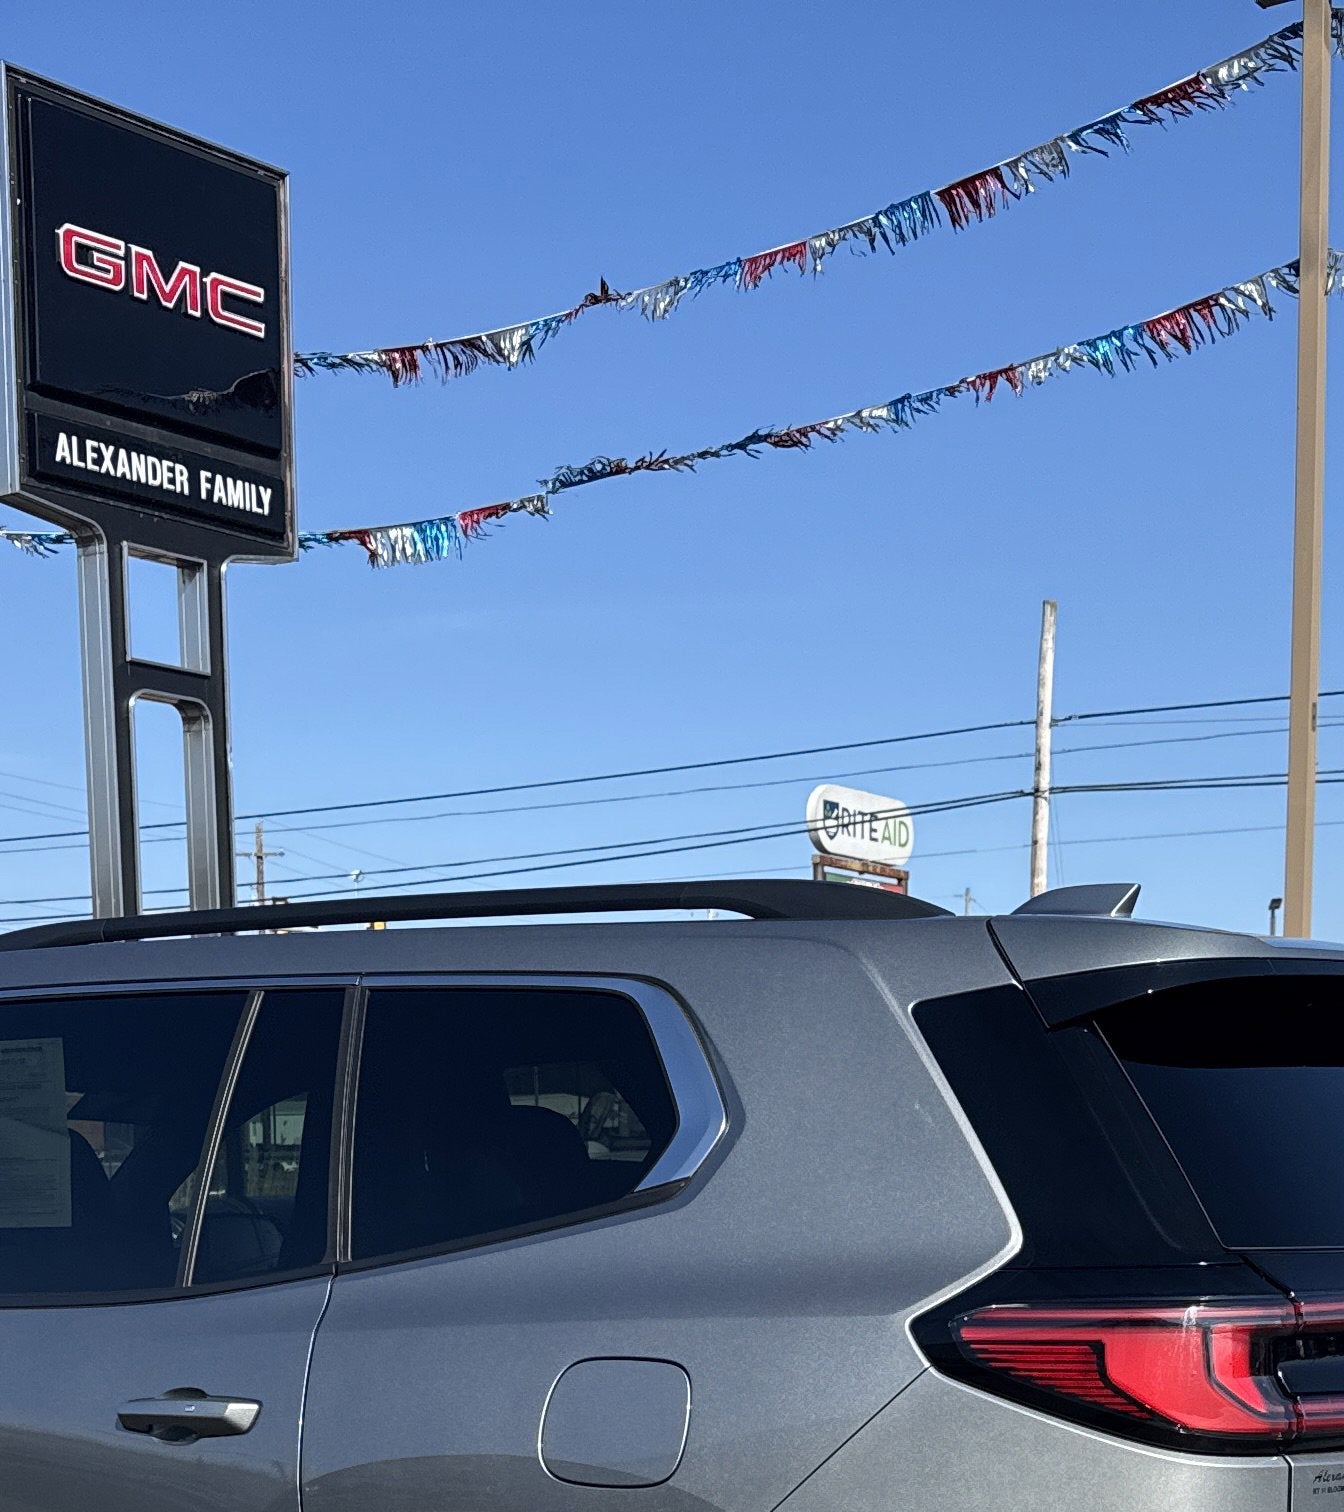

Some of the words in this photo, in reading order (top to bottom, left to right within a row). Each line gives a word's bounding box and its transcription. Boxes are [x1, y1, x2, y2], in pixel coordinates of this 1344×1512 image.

[55, 223, 266, 339] GMC
[55, 432, 190, 496] ALEXANDER
[199, 469, 273, 517] FAMILY
[841, 806, 879, 843] RITE
[880, 819, 910, 848] AID
